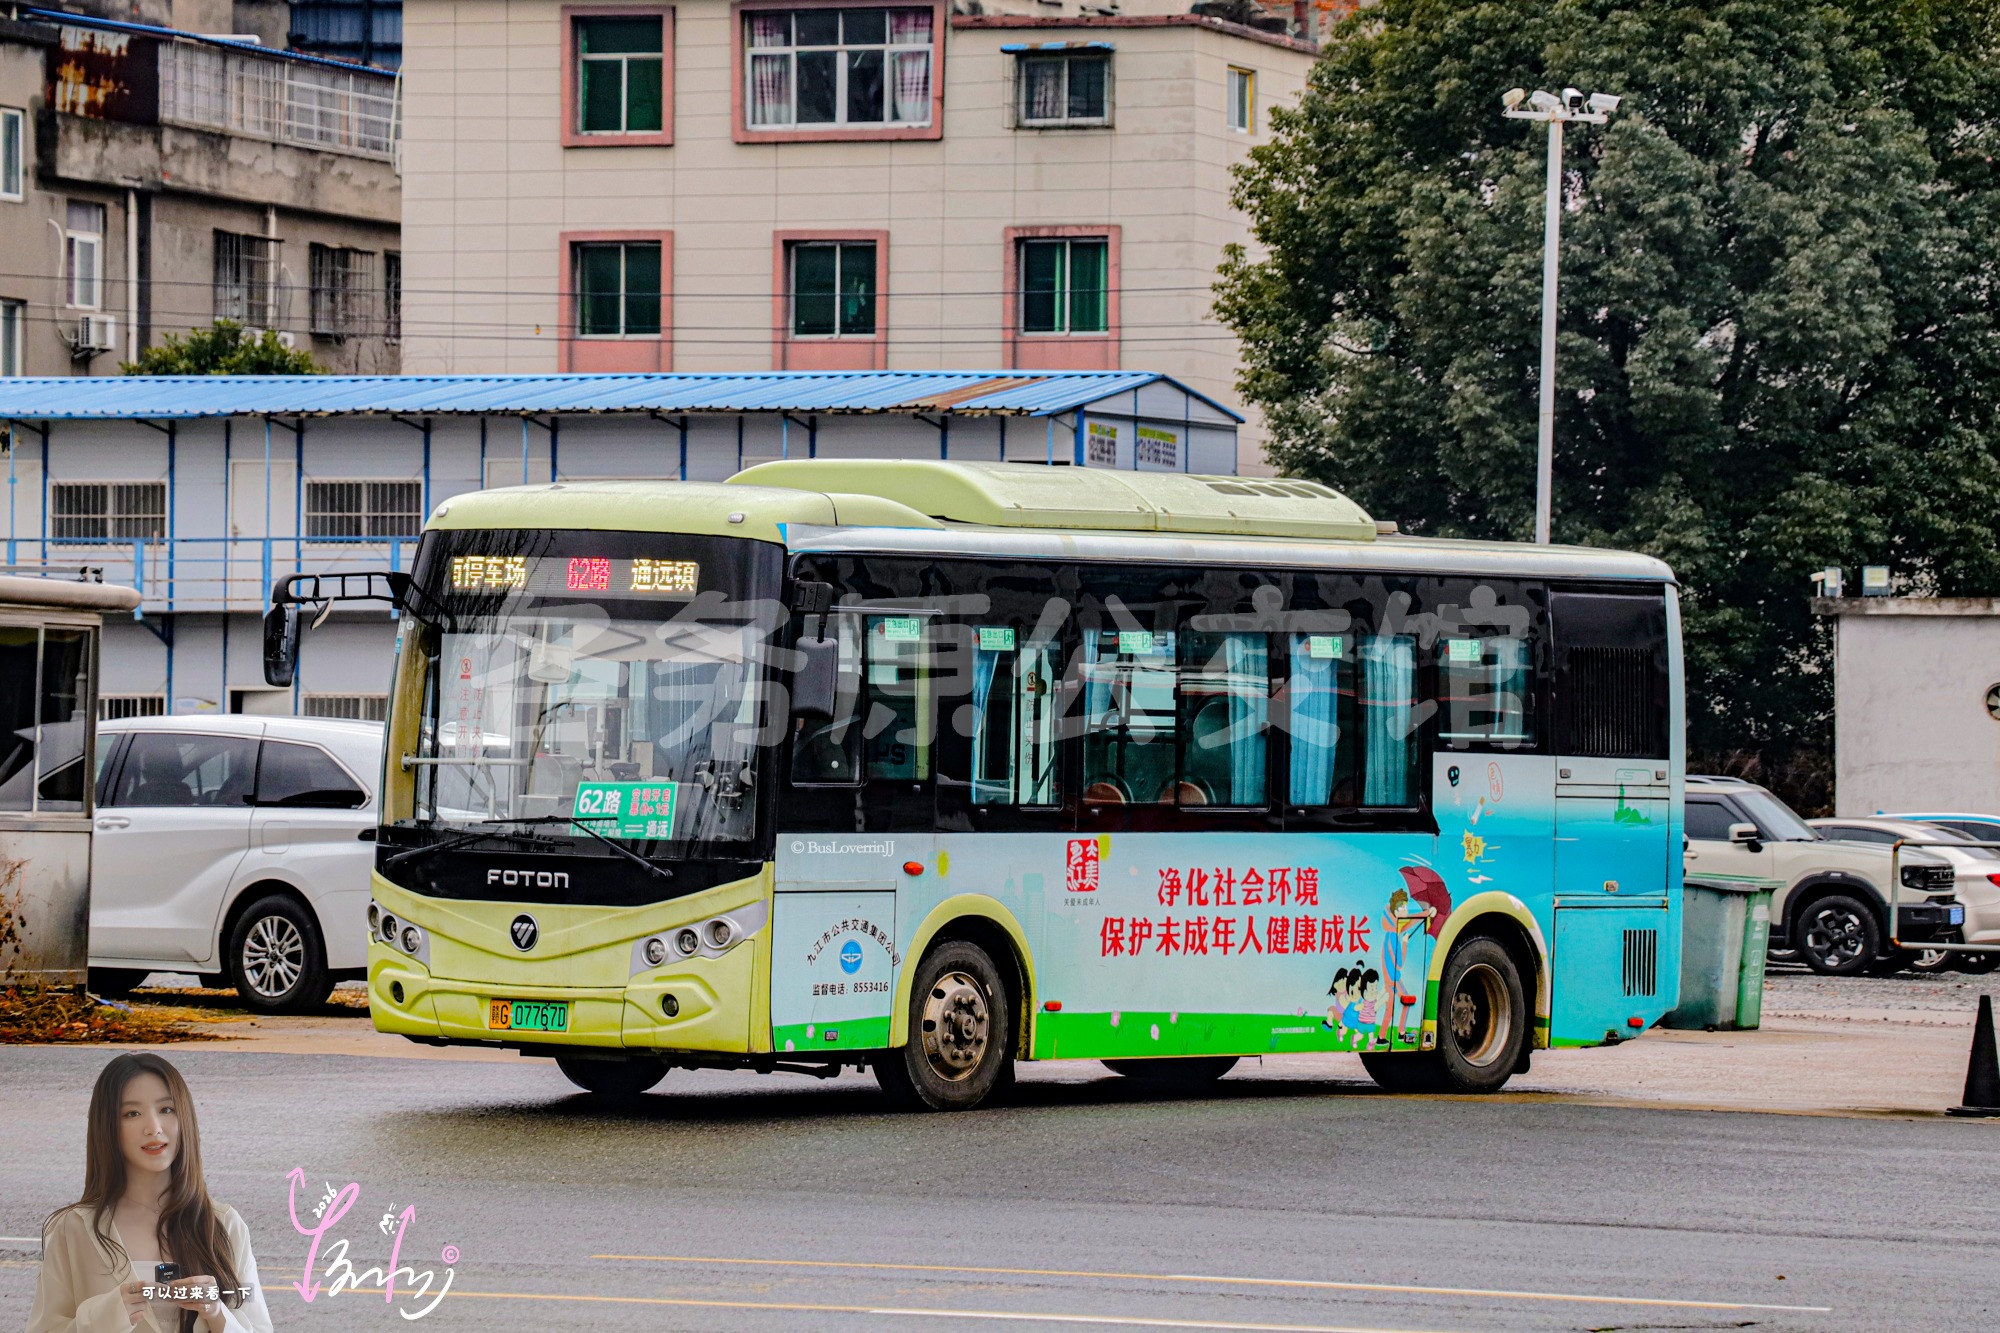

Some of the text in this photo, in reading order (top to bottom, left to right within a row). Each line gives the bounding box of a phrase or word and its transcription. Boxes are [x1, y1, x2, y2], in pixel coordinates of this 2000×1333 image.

[567, 557, 610, 590] 62路
[630, 558, 696, 591] 通远镇
[578, 789, 622, 815] 62路
[632, 788, 671, 802] 空调开启
[487, 868, 569, 889] FOTON
[1157, 867, 1319, 907] 净化社会环境
[806, 918, 901, 967] 九江市公共交通集团公司
[1100, 915, 1371, 957] 保护未成年人健康成长
[853, 982, 888, 994] 8553416
